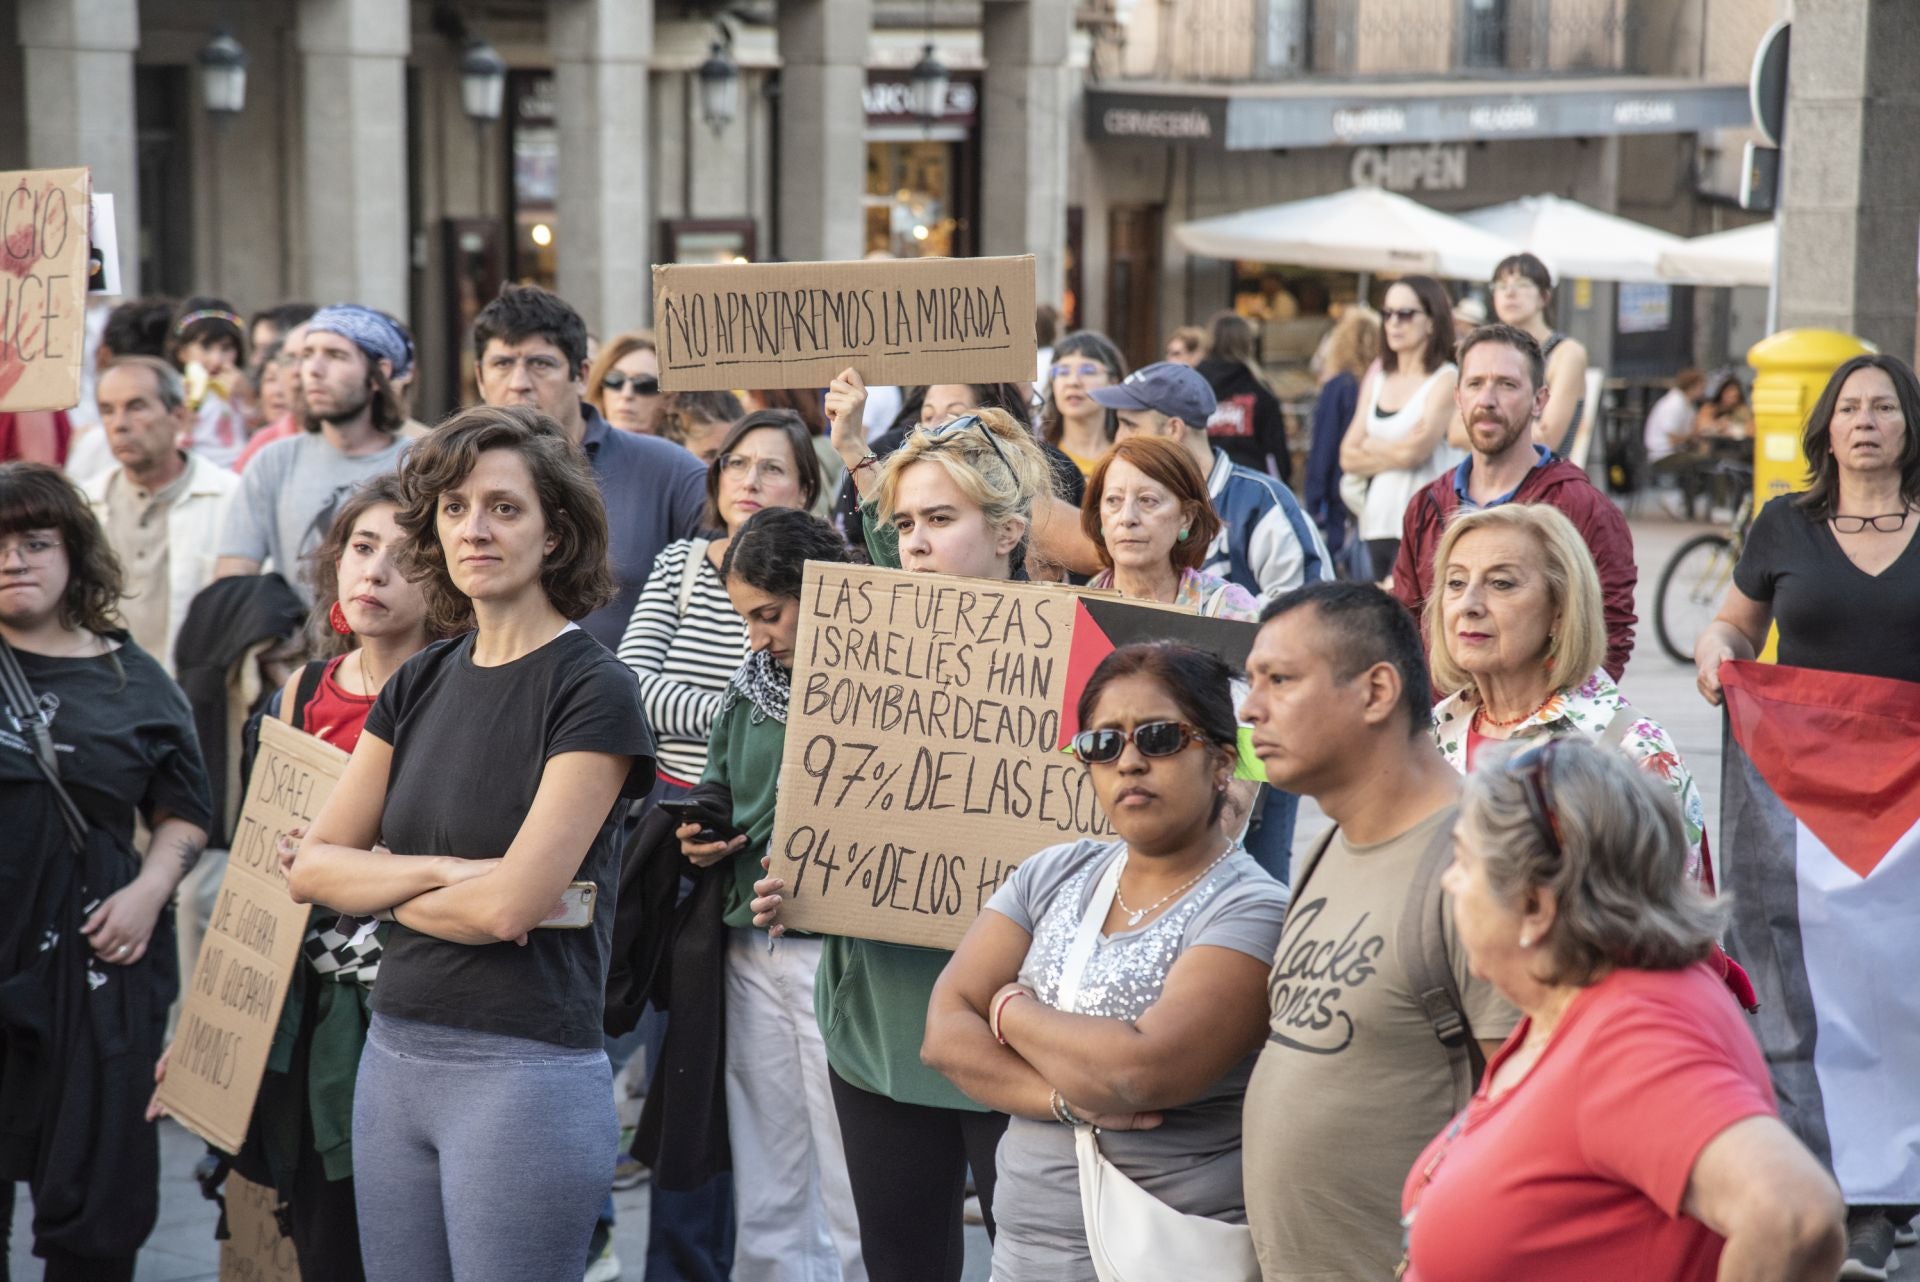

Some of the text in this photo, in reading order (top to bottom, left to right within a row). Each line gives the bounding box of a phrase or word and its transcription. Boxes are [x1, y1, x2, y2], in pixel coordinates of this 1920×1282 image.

[1352, 140, 1467, 191] CHIPÉN
[0, 187, 68, 260] CIO
[665, 285, 1011, 362] NO APARTAREMOS LA MIRADA
[813, 574, 1053, 650] LAS FUERZAS
[810, 624, 1054, 700] ISRAELÍES HAN
[803, 672, 1059, 753] BOMBARDEADO
[256, 752, 314, 822] ISRAEL
[803, 734, 902, 811] 97%
[1038, 764, 1119, 836] ESCU
[238, 816, 268, 867] TUS
[784, 825, 876, 899] 94%
[213, 888, 278, 956] DE GUERRA
[196, 945, 223, 997] NO
[179, 1012, 243, 1090] IMPUNES
